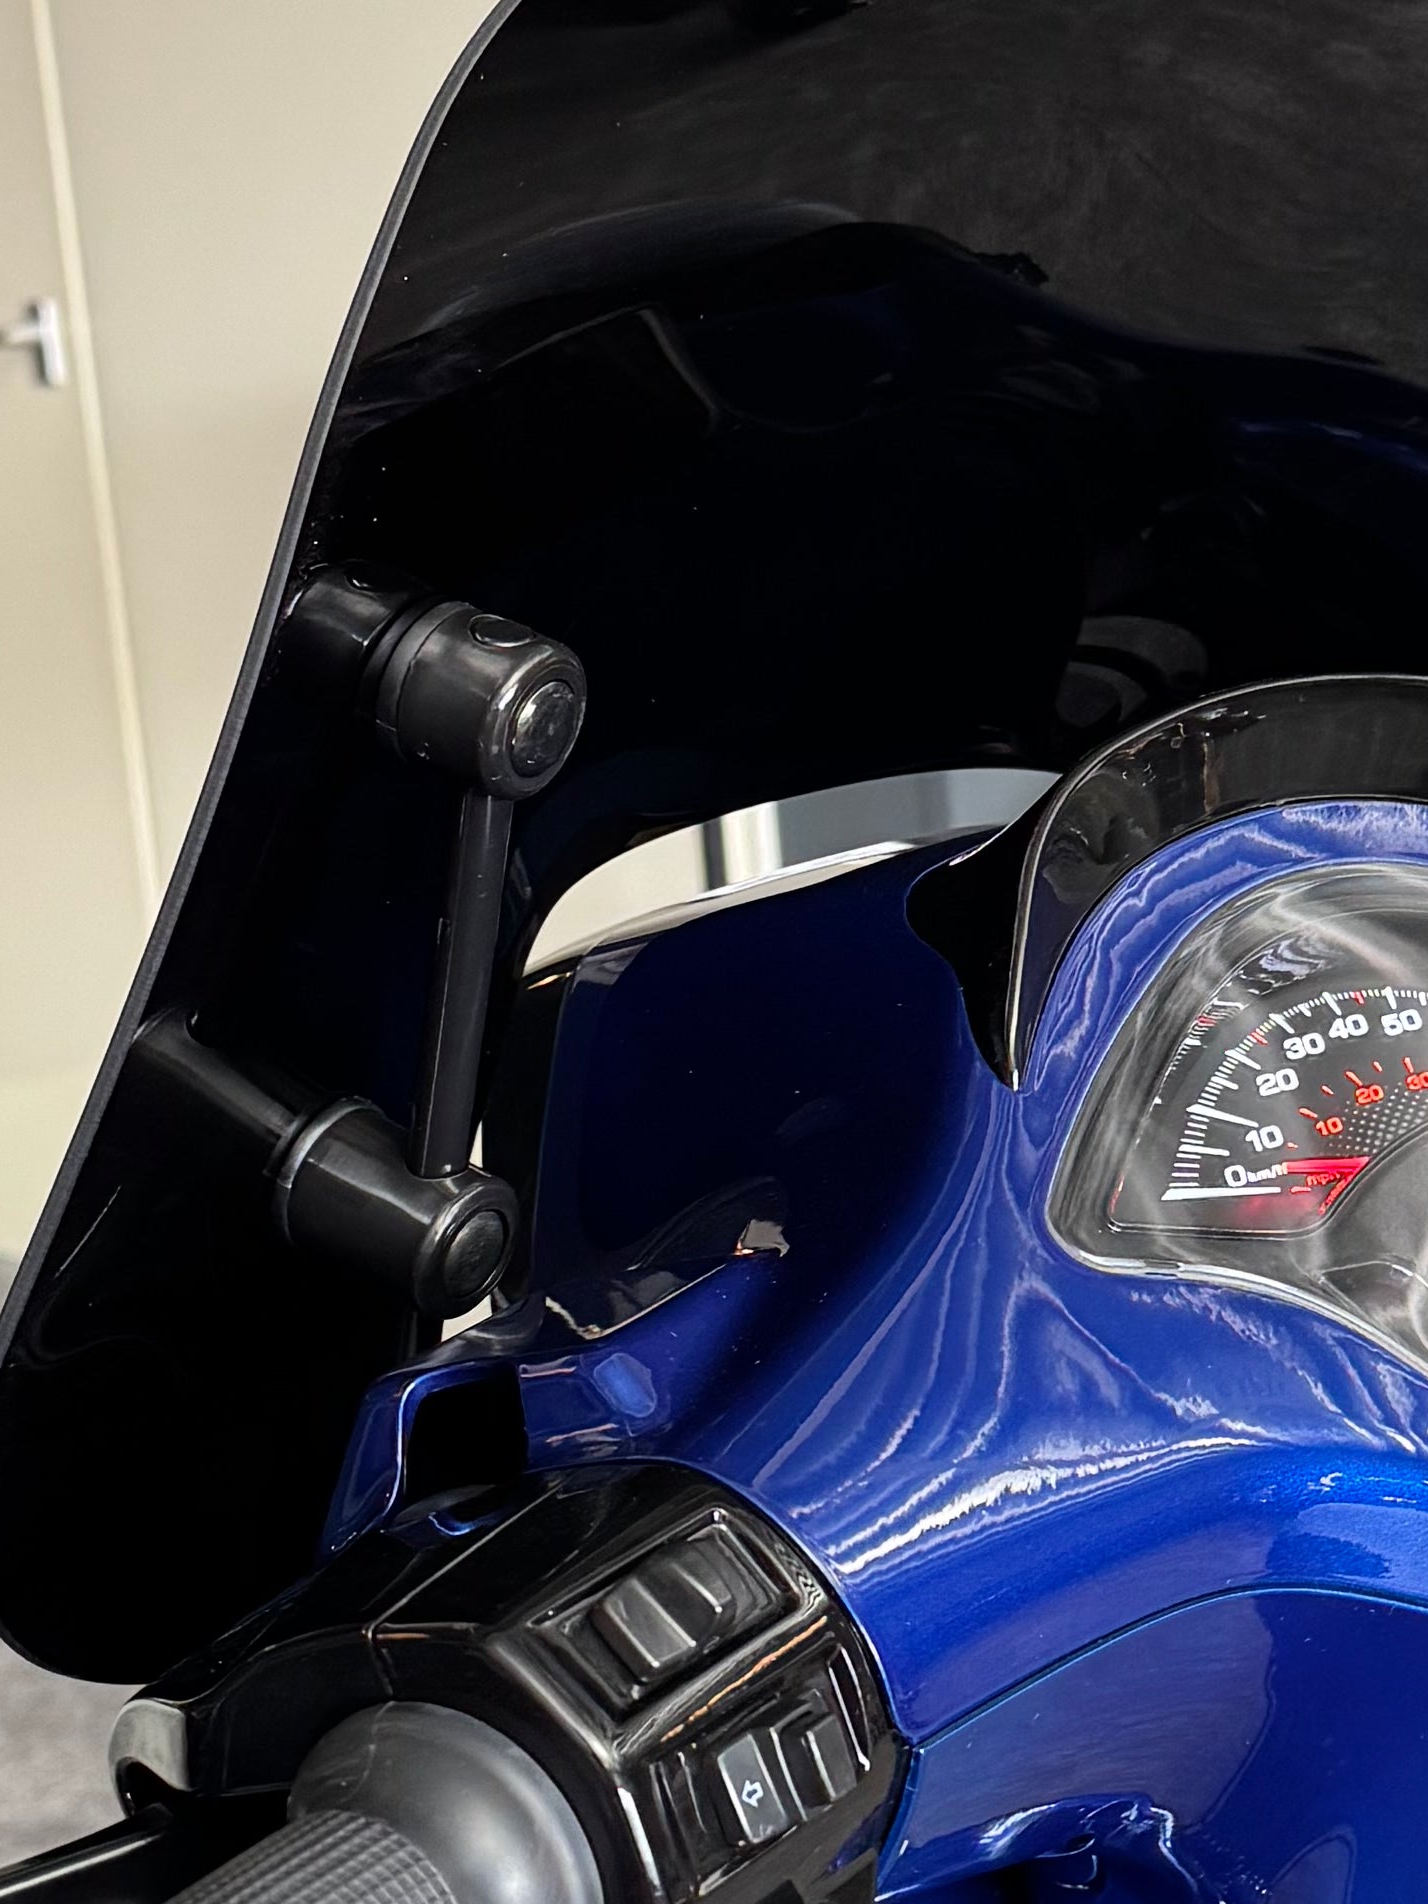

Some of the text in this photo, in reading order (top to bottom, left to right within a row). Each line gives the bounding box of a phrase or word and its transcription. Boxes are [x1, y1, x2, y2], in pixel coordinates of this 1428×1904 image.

[1329, 1013, 1370, 1040] 40
[1380, 1008, 1424, 1037] 50
[1283, 1032, 1327, 1061] 30
[1255, 1067, 1300, 1097] 20
[1355, 1084, 1385, 1106] 20
[1245, 1124, 1285, 1153] 10
[1315, 1116, 1344, 1137] 10
[1224, 1164, 1248, 1188] 0
